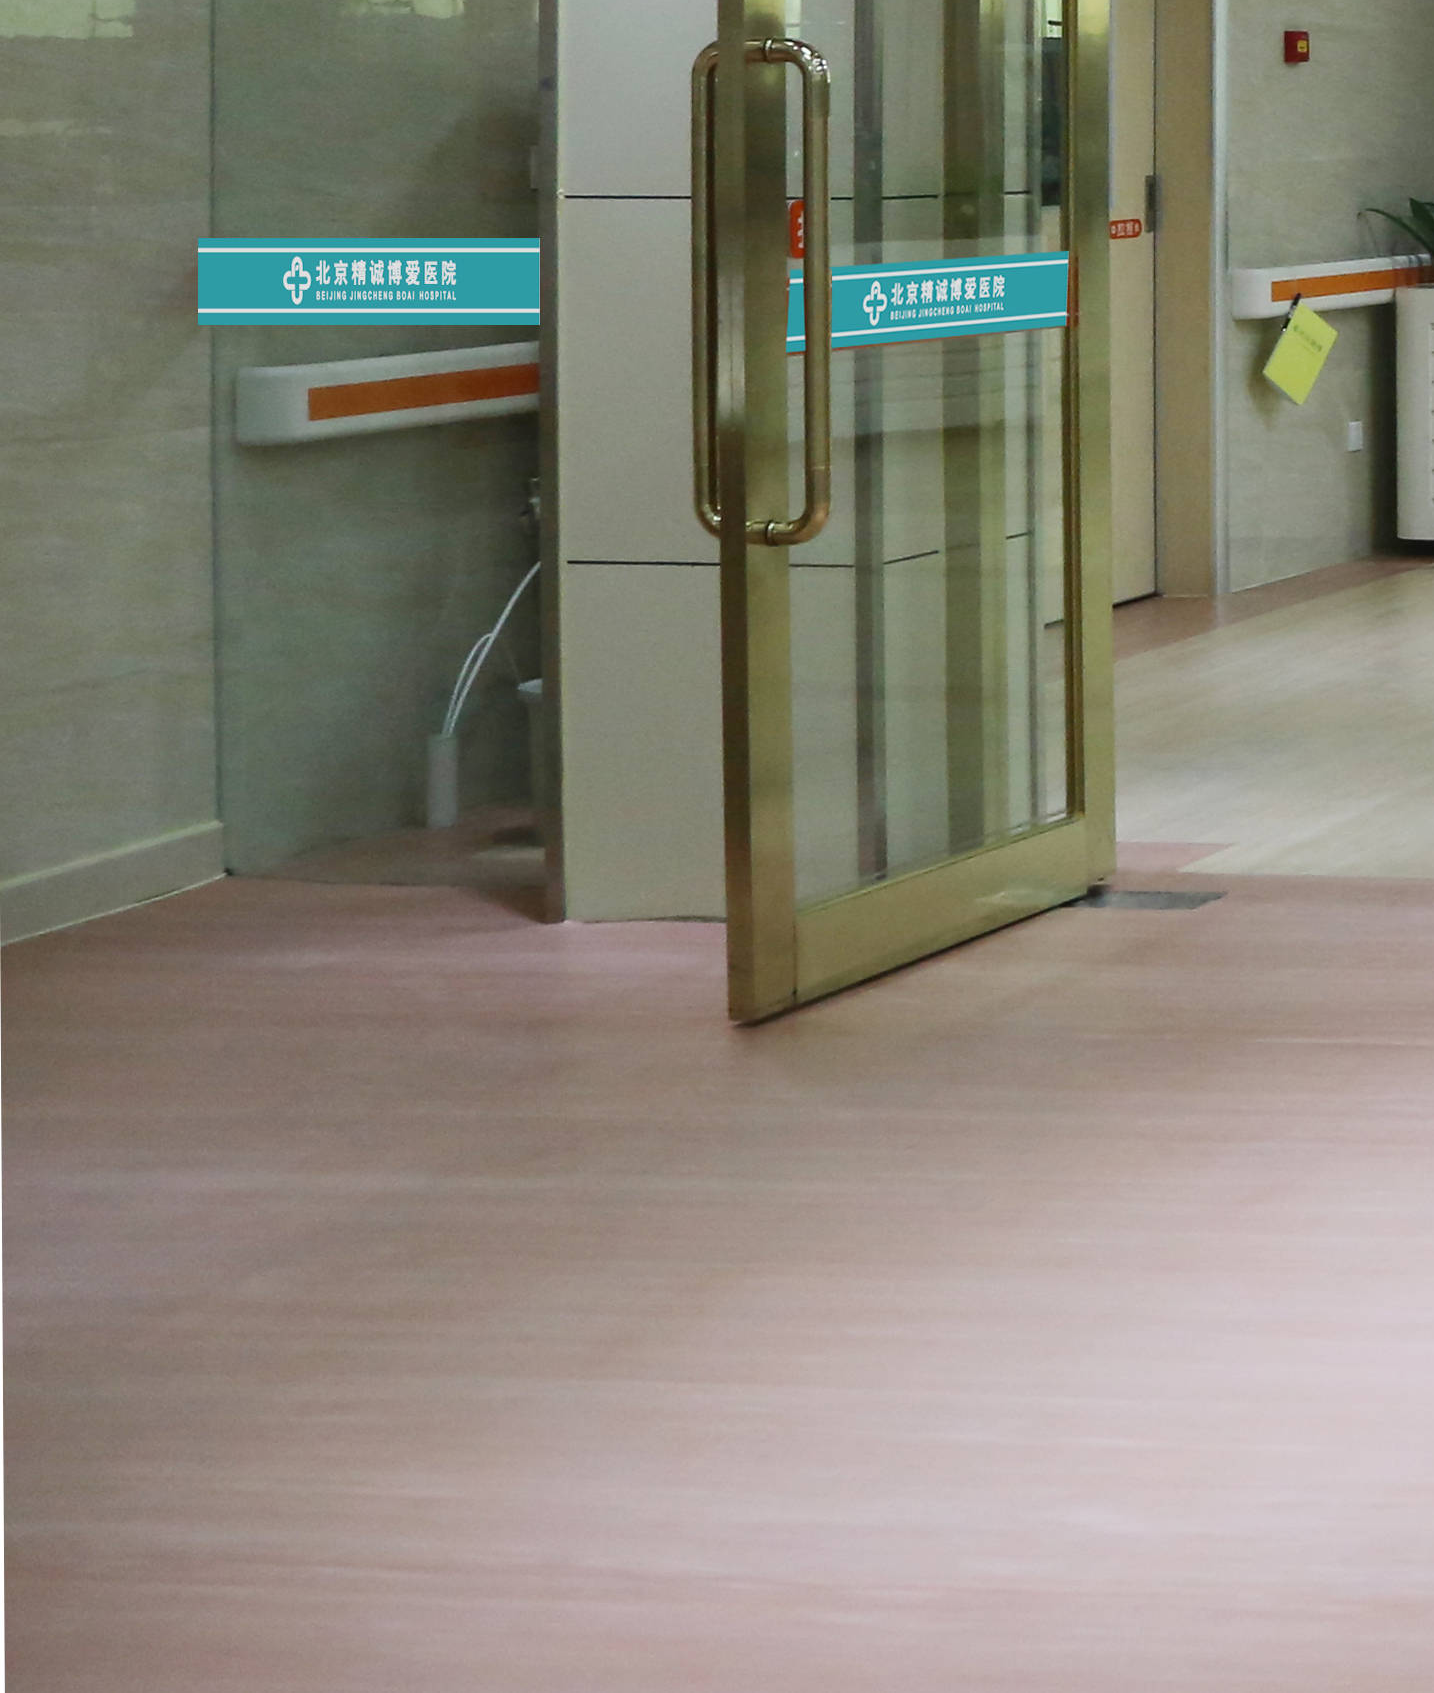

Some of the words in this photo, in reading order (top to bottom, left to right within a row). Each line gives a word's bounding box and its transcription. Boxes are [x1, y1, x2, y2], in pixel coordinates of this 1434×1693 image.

[316, 259, 457, 286] 北京精诚博爱医院
[316, 291, 347, 301] BEIJING
[350, 291, 394, 301] JINGCHENG
[396, 291, 415, 301] BOAI
[419, 291, 457, 301] HOSPITAL
[890, 274, 1006, 306] 北京精诚博爱医院
[890, 308, 916, 321] BEIJING
[918, 305, 955, 318] JINGCHENG
[956, 304, 972, 315] BOAI
[974, 302, 1005, 313] HOSPITAL
